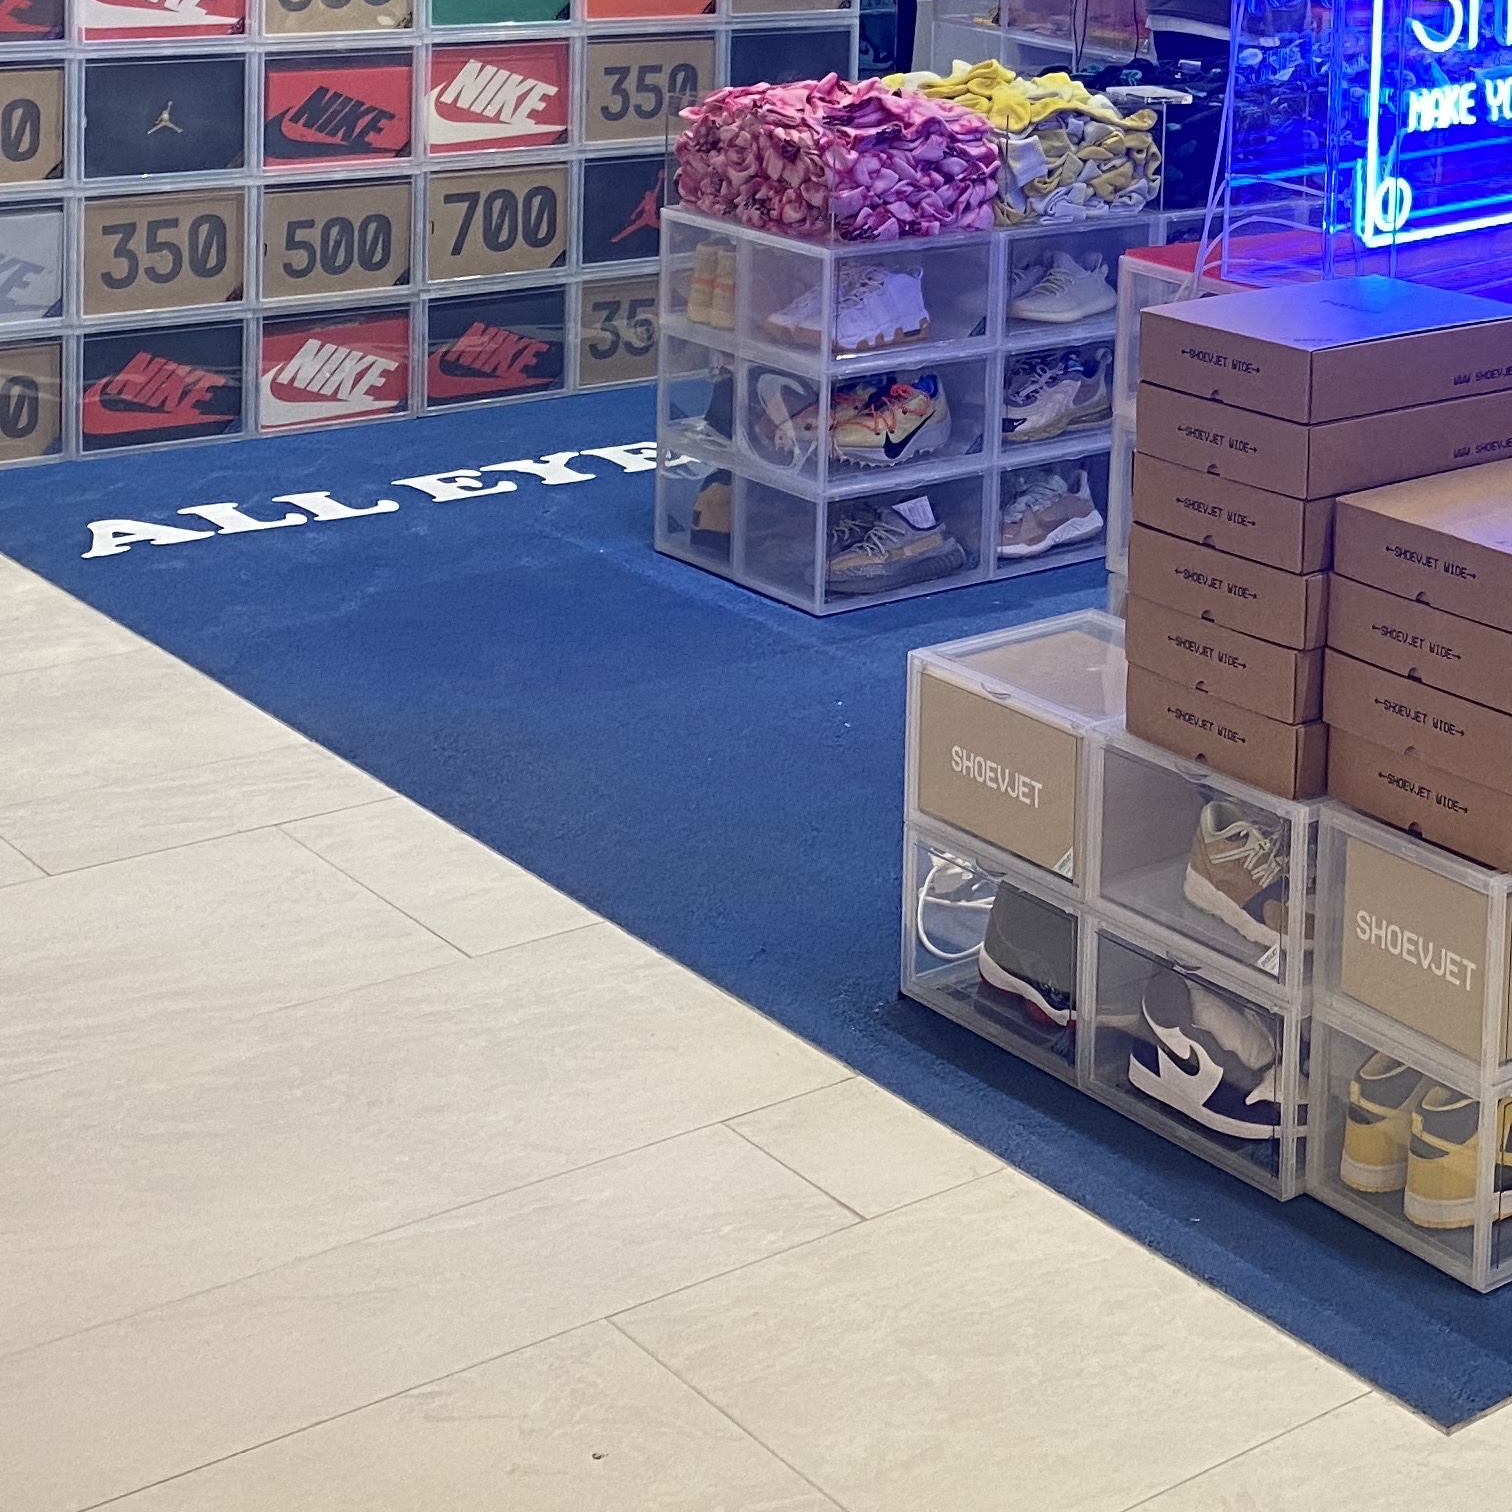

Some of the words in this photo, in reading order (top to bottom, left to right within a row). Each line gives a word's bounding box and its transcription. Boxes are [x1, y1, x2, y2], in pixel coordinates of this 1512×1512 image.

[292, 86, 395, 147] NIKE
[445, 59, 560, 128] NIKE
[600, 63, 698, 122] 350
[1407, 82, 1477, 133] MAKE
[283, 213, 393, 279] 500
[443, 185, 558, 257] 700
[101, 213, 227, 289] 350
[454, 322, 551, 380] NIKE
[588, 297, 656, 360] 35
[118, 351, 227, 415] NIKE
[280, 338, 398, 403] NIKE
[1189, 348, 1228, 369] SHOEVJET
[1231, 357, 1252, 374] WIDE
[1185, 425, 1225, 446] SHOEVJET
[1228, 435, 1249, 453] WIDE
[81, 490, 399, 558] ALL
[392, 439, 660, 503] EYE
[1183, 497, 1223, 518] SHOEVJET
[1226, 509, 1247, 526] WIDE
[1183, 568, 1223, 590] SHOEVJET
[1227, 580, 1249, 598] WIDE
[1395, 546, 1439, 569] SHOEVJET
[1443, 560, 1467, 579] WIDE
[1175, 636, 1214, 658] SHOEVJET
[1217, 649, 1239, 668] WIDE
[1380, 625, 1425, 650] SHOEVJET
[1429, 641, 1453, 660] WIDE
[1175, 709, 1214, 731] SHOEVJET
[1217, 723, 1238, 743] WIDE
[1383, 699, 1428, 725] SHOEVJET
[1432, 714, 1456, 736] WIDE
[951, 745, 1042, 809] SHOEVJET
[1387, 773, 1431, 799] SHOEVJET
[1436, 791, 1460, 812] WIDE
[1356, 909, 1477, 991] SHOEVJET
